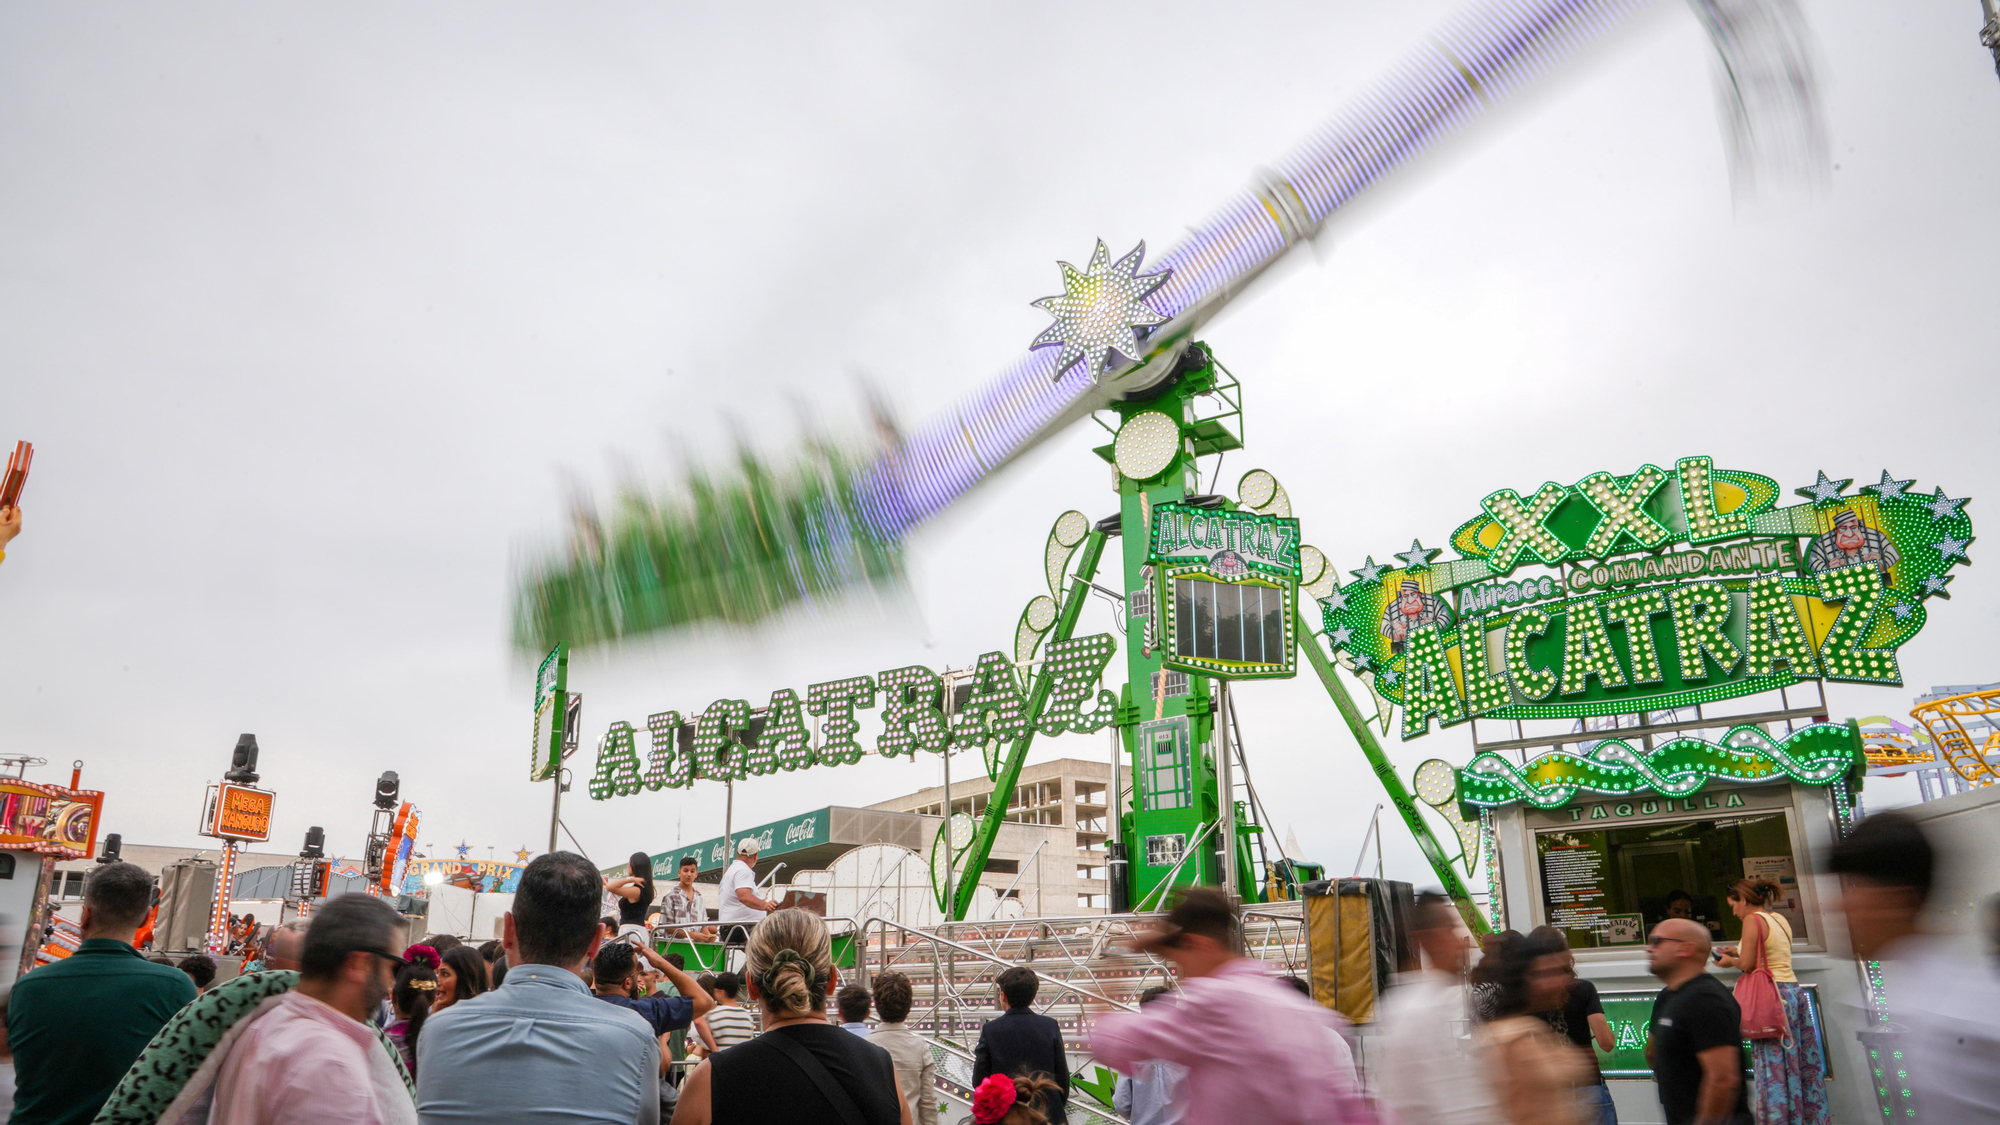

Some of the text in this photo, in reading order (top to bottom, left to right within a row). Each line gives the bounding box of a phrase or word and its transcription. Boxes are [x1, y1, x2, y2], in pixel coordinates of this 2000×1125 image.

[1479, 455, 1754, 574] XXL
[1157, 511, 1295, 568] ALCATRAZ
[1458, 537, 1798, 618] Atracc. COMANDANTE
[1400, 562, 1904, 741] ALCATRAZ
[588, 632, 1119, 801] ALCATRAZ
[230, 792, 264, 814] MEGA
[1567, 793, 1746, 822] TAQUILLA
[221, 809, 269, 833] KANGURO
[785, 816, 818, 845] Coca-Cola
[410, 862, 515, 880] GRAND PRIX
[652, 855, 674, 878] Coca-Cola
[1615, 927, 1627, 936] 5€
